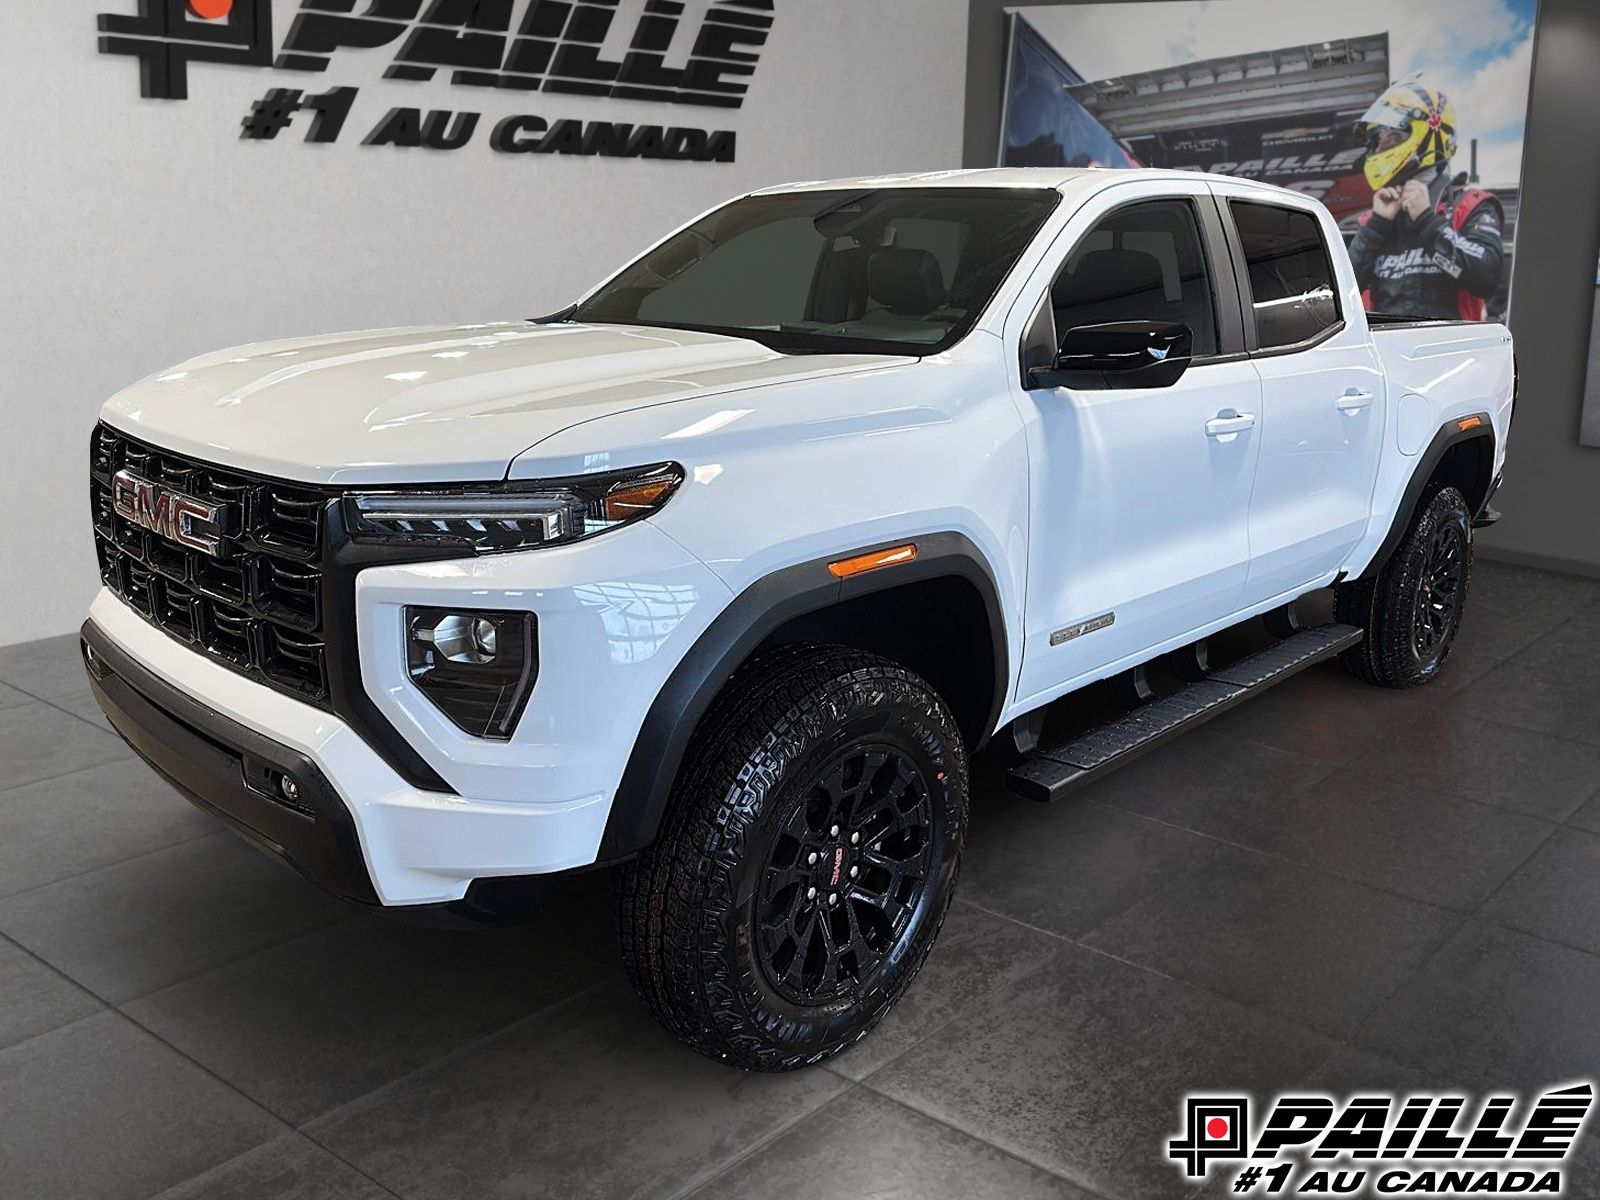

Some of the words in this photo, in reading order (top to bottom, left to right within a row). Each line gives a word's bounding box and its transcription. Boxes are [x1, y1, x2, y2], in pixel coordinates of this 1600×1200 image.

[240, 85, 360, 143] #1
[359, 107, 482, 150] AU
[488, 114, 737, 163] CANADA
[1264, 164, 1353, 177] CANADA
[112, 470, 219, 557] GMC
[830, 847, 843, 886] GMC
